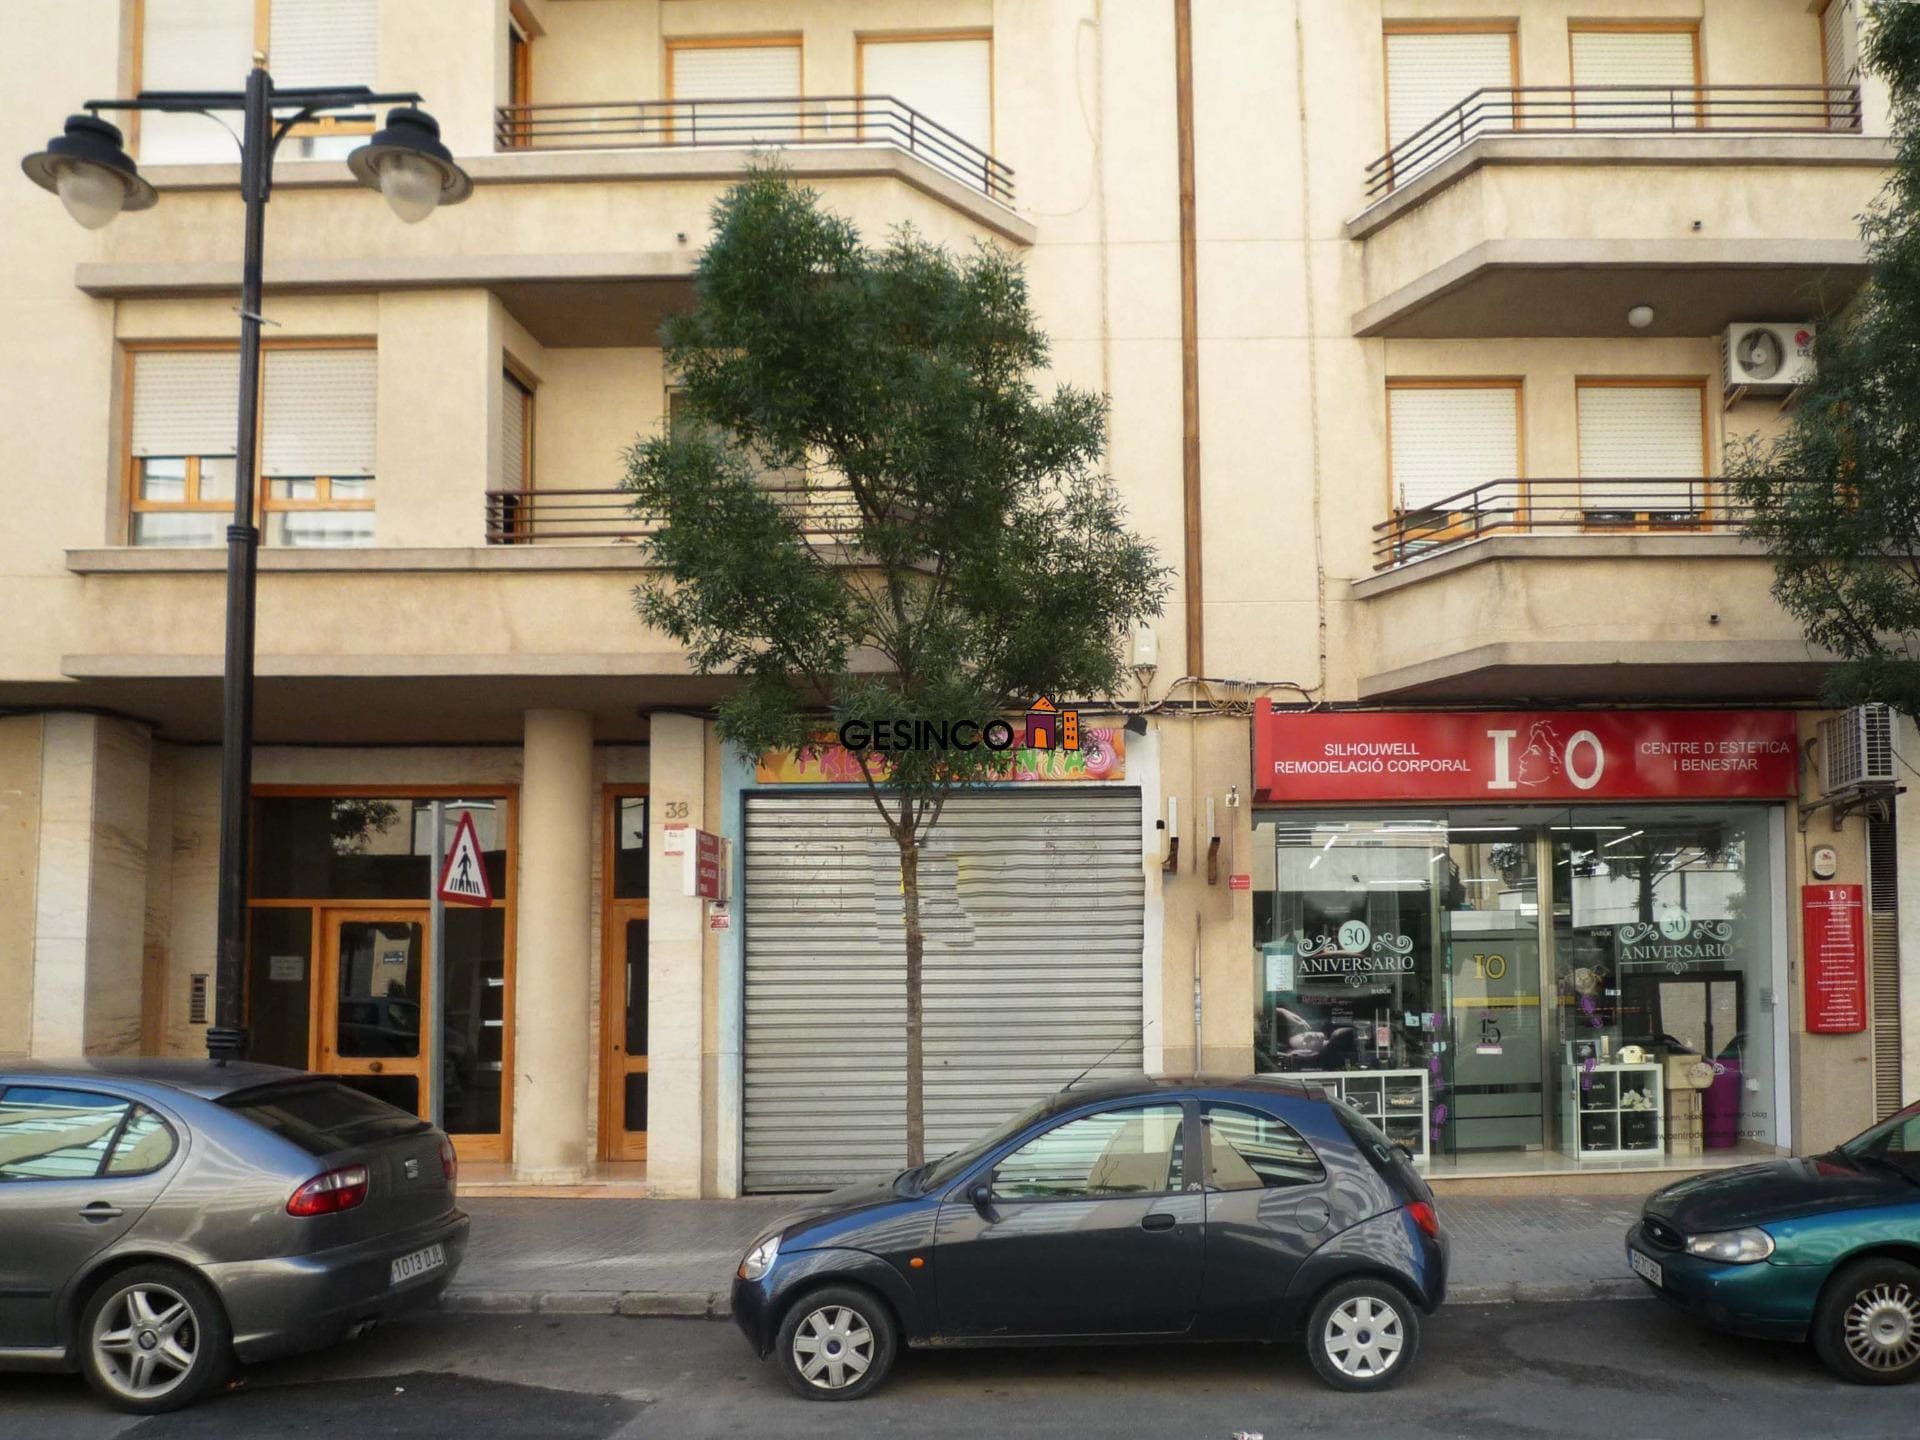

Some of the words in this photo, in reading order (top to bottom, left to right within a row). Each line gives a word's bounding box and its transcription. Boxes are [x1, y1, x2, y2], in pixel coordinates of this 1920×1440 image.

[1324, 743, 1420, 756] SILHOUWELL
[1641, 742, 1699, 754] CENTRE
[1274, 758, 1384, 773] REMODELACIÓ
[1387, 759, 1471, 772] CORPORAL
[1673, 758, 1678, 771] I
[1681, 758, 1758, 771] BENESTAR
[664, 801, 689, 819] 38
[1665, 916, 1687, 934] 30
[1344, 928, 1366, 946] 30
[1620, 943, 1734, 960] ANIVERSARIO
[1298, 956, 1415, 973] ANIVERSARIO
[395, 1253, 423, 1280] 1013
